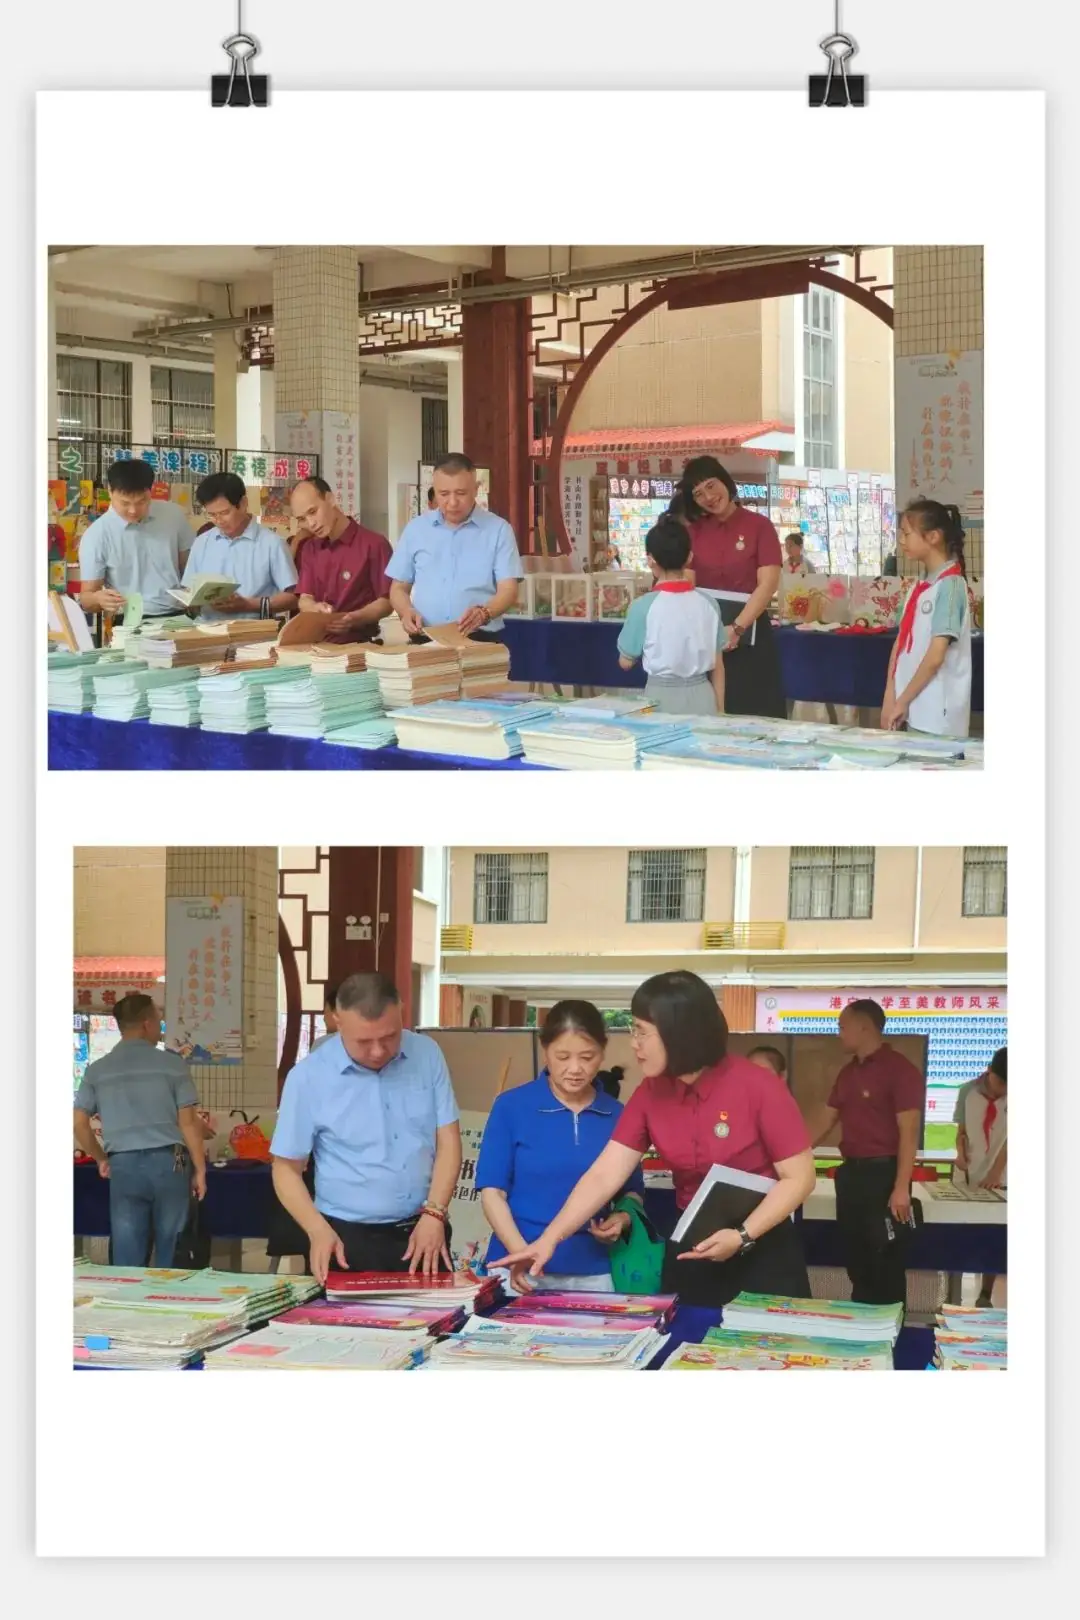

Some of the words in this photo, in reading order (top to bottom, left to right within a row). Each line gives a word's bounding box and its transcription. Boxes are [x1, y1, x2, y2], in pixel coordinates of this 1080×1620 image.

[60, 449, 83, 474] 之
[829, 996, 1000, 1009] 港学至美教师风采
